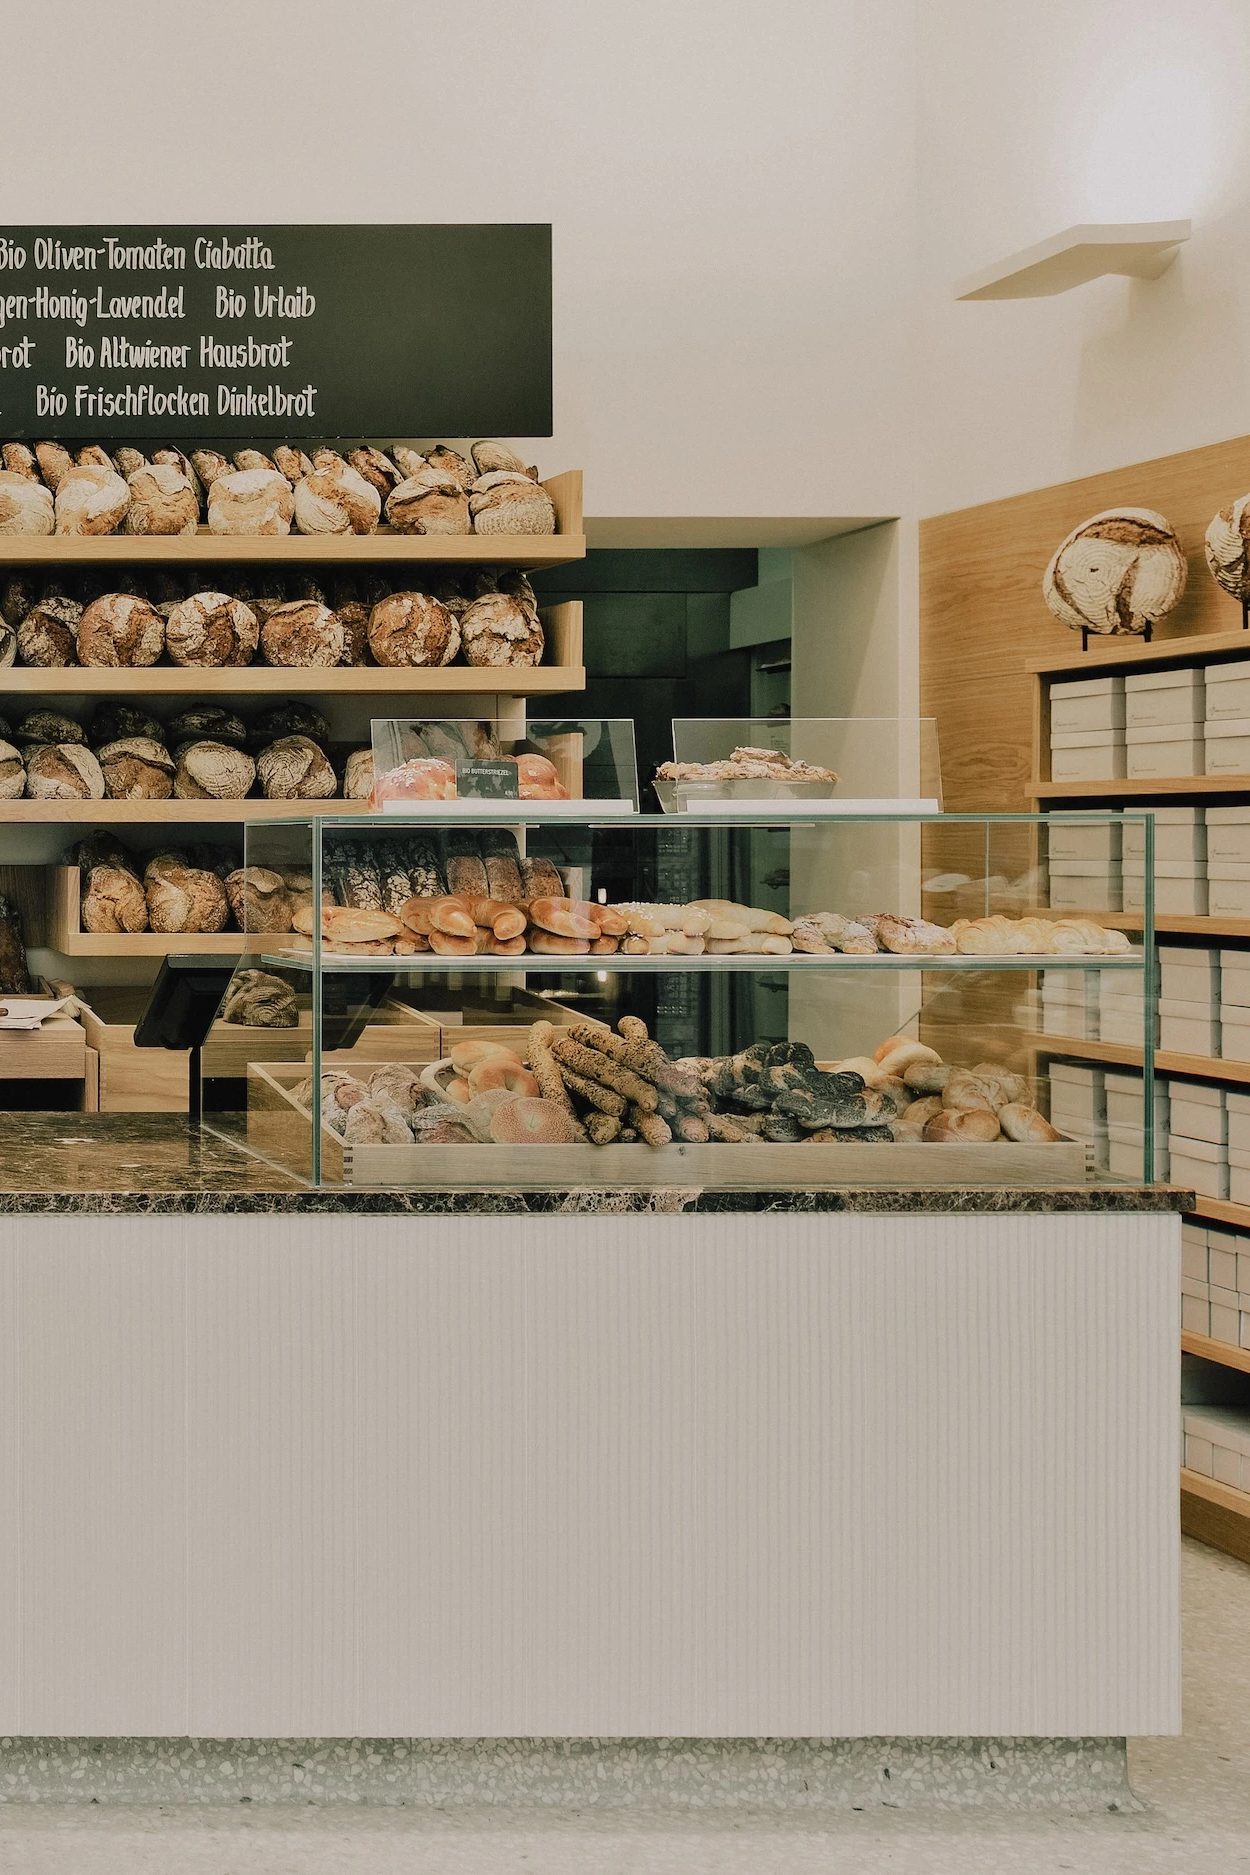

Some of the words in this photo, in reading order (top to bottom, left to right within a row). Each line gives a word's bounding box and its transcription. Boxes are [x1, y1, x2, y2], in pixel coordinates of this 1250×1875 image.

[34, 237, 186, 270] Oliven-Tomaten
[194, 237, 276, 270] Ciabatta
[215, 286, 247, 318] Bio
[254, 286, 316, 318] Urlaib
[65, 337, 95, 368] Bio
[100, 336, 191, 368] Altwiener
[199, 336, 294, 368] Hausbrot
[36, 385, 68, 417] Bio
[75, 385, 209, 417] Frischflocken
[217, 385, 318, 417] Dinkelbrot
